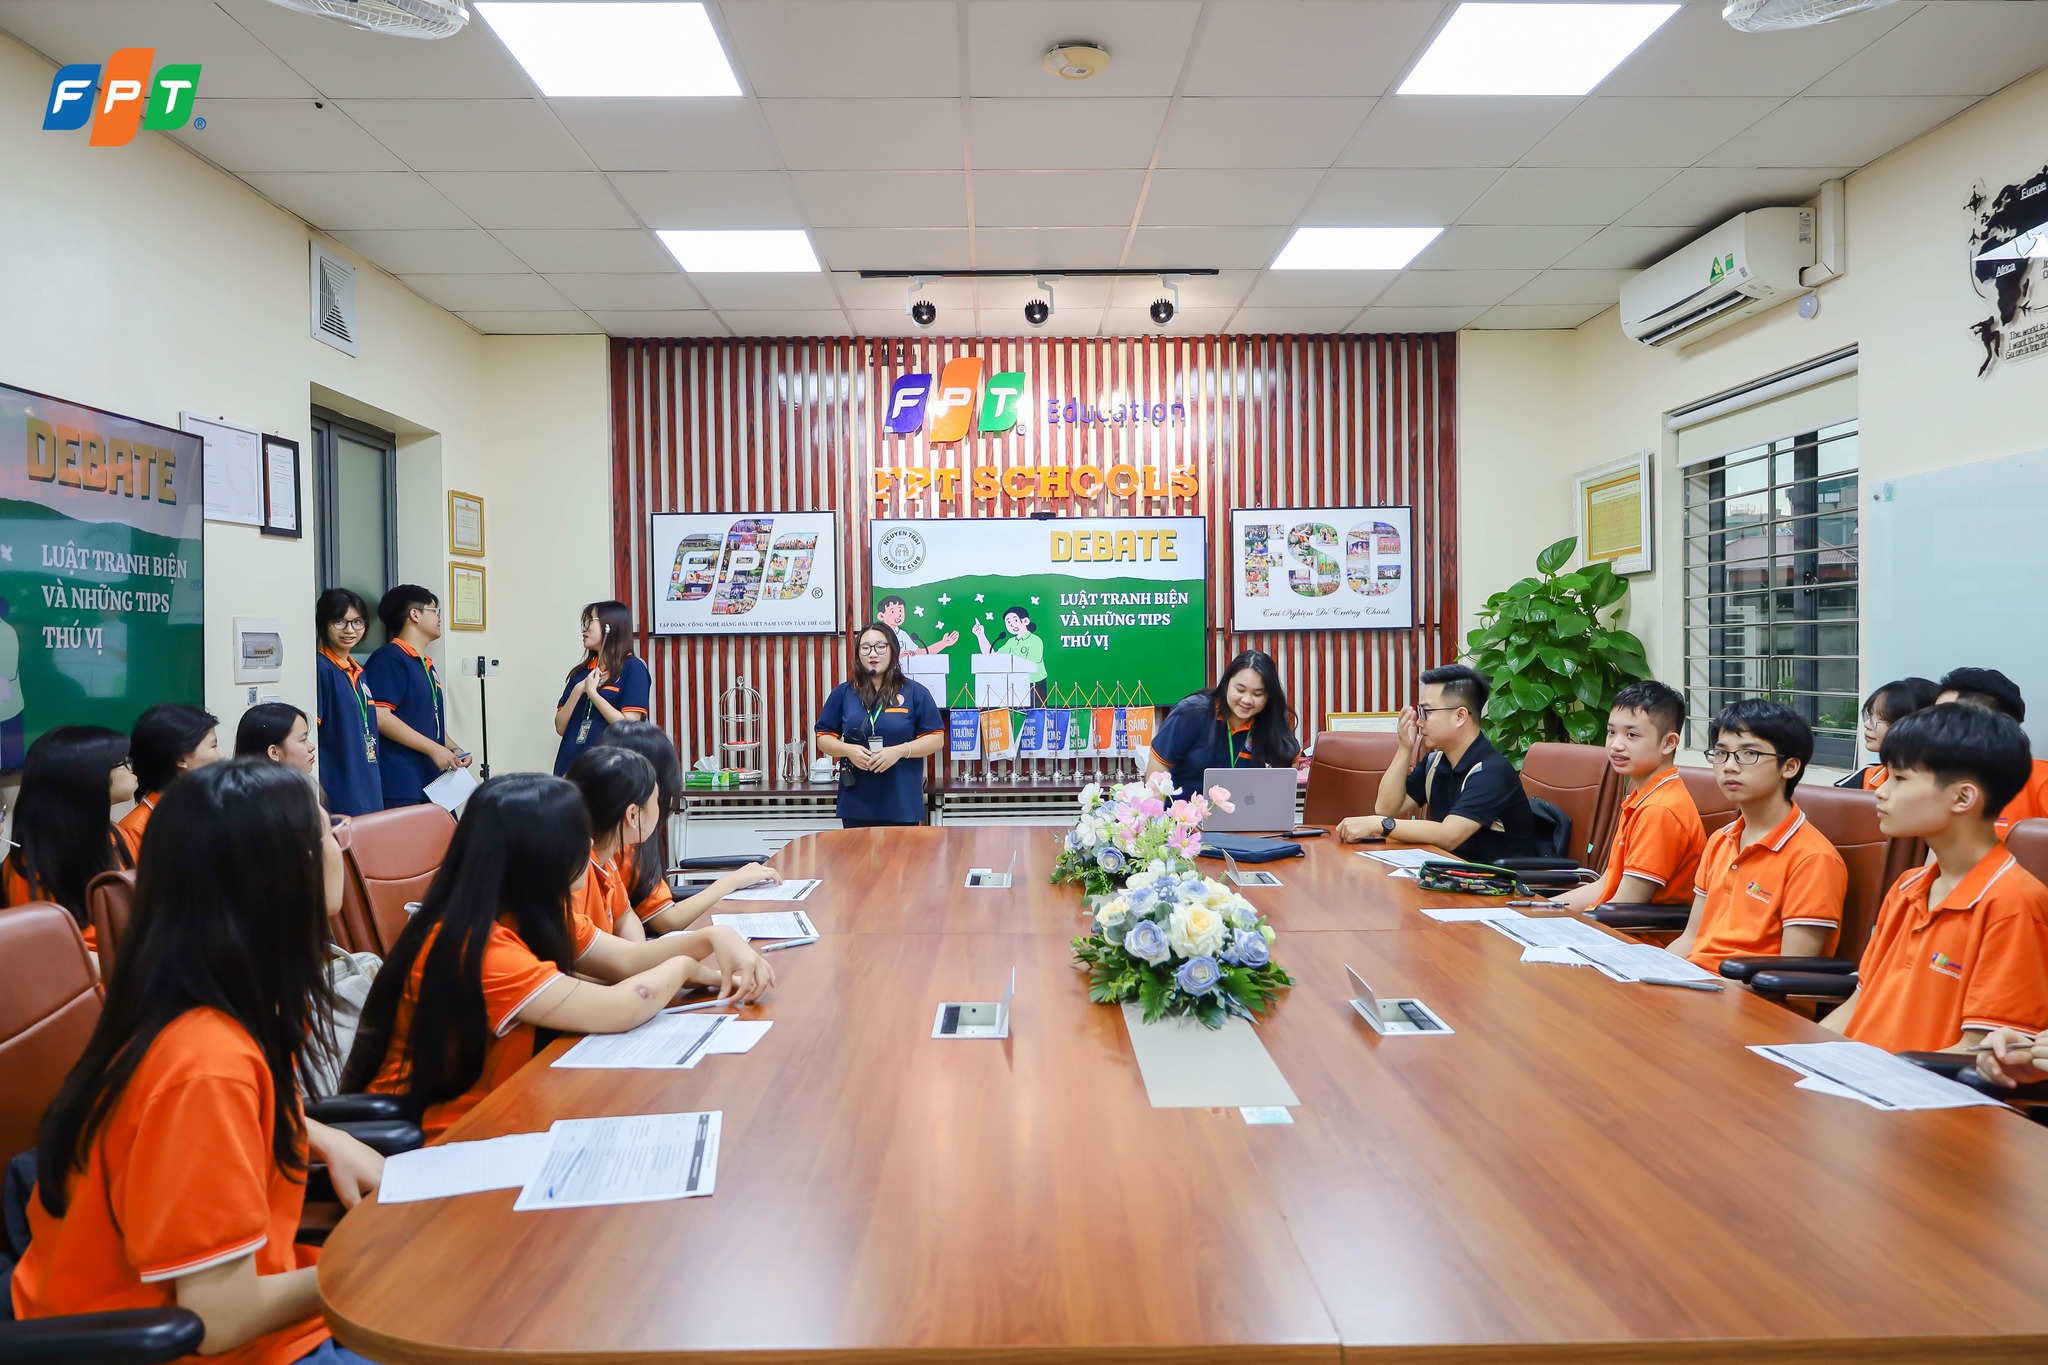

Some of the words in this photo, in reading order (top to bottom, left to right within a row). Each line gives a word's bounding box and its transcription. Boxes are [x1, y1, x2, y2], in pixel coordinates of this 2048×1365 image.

[2020, 180, 2047, 199] Europe
[1995, 261, 2017, 278] Africa
[1047, 397, 1186, 424] Education
[27, 416, 177, 506] DEBATE
[874, 467, 961, 501] FPT
[973, 464, 1199, 499] SCHOOLS
[883, 530, 908, 546] NGUYEN
[908, 532, 921, 546] TRAI
[1050, 529, 1178, 562] DEBATE
[42, 540, 90, 576] LUẬT
[92, 550, 150, 576] TRANH
[152, 552, 188, 585] BIỆN
[883, 556, 907, 571] DEBATE
[907, 556, 921, 570] CLUB
[1244, 521, 1402, 598] FSC
[41, 578, 69, 608] VÀ
[71, 583, 134, 612] NHỮNG
[135, 592, 171, 614] TIPS
[1060, 589, 1099, 609] LUẬT
[1100, 592, 1152, 606] TRANH
[1153, 588, 1190, 609] BIỆN
[1060, 610, 1081, 627] VÀ
[1083, 611, 1136, 627] NHỮNG
[1137, 613, 1172, 627] TIPS
[42, 619, 82, 649] THÚ
[84, 628, 103, 656] VỊ
[1060, 631, 1092, 648] THÚ
[1092, 634, 1109, 651] VỊ
